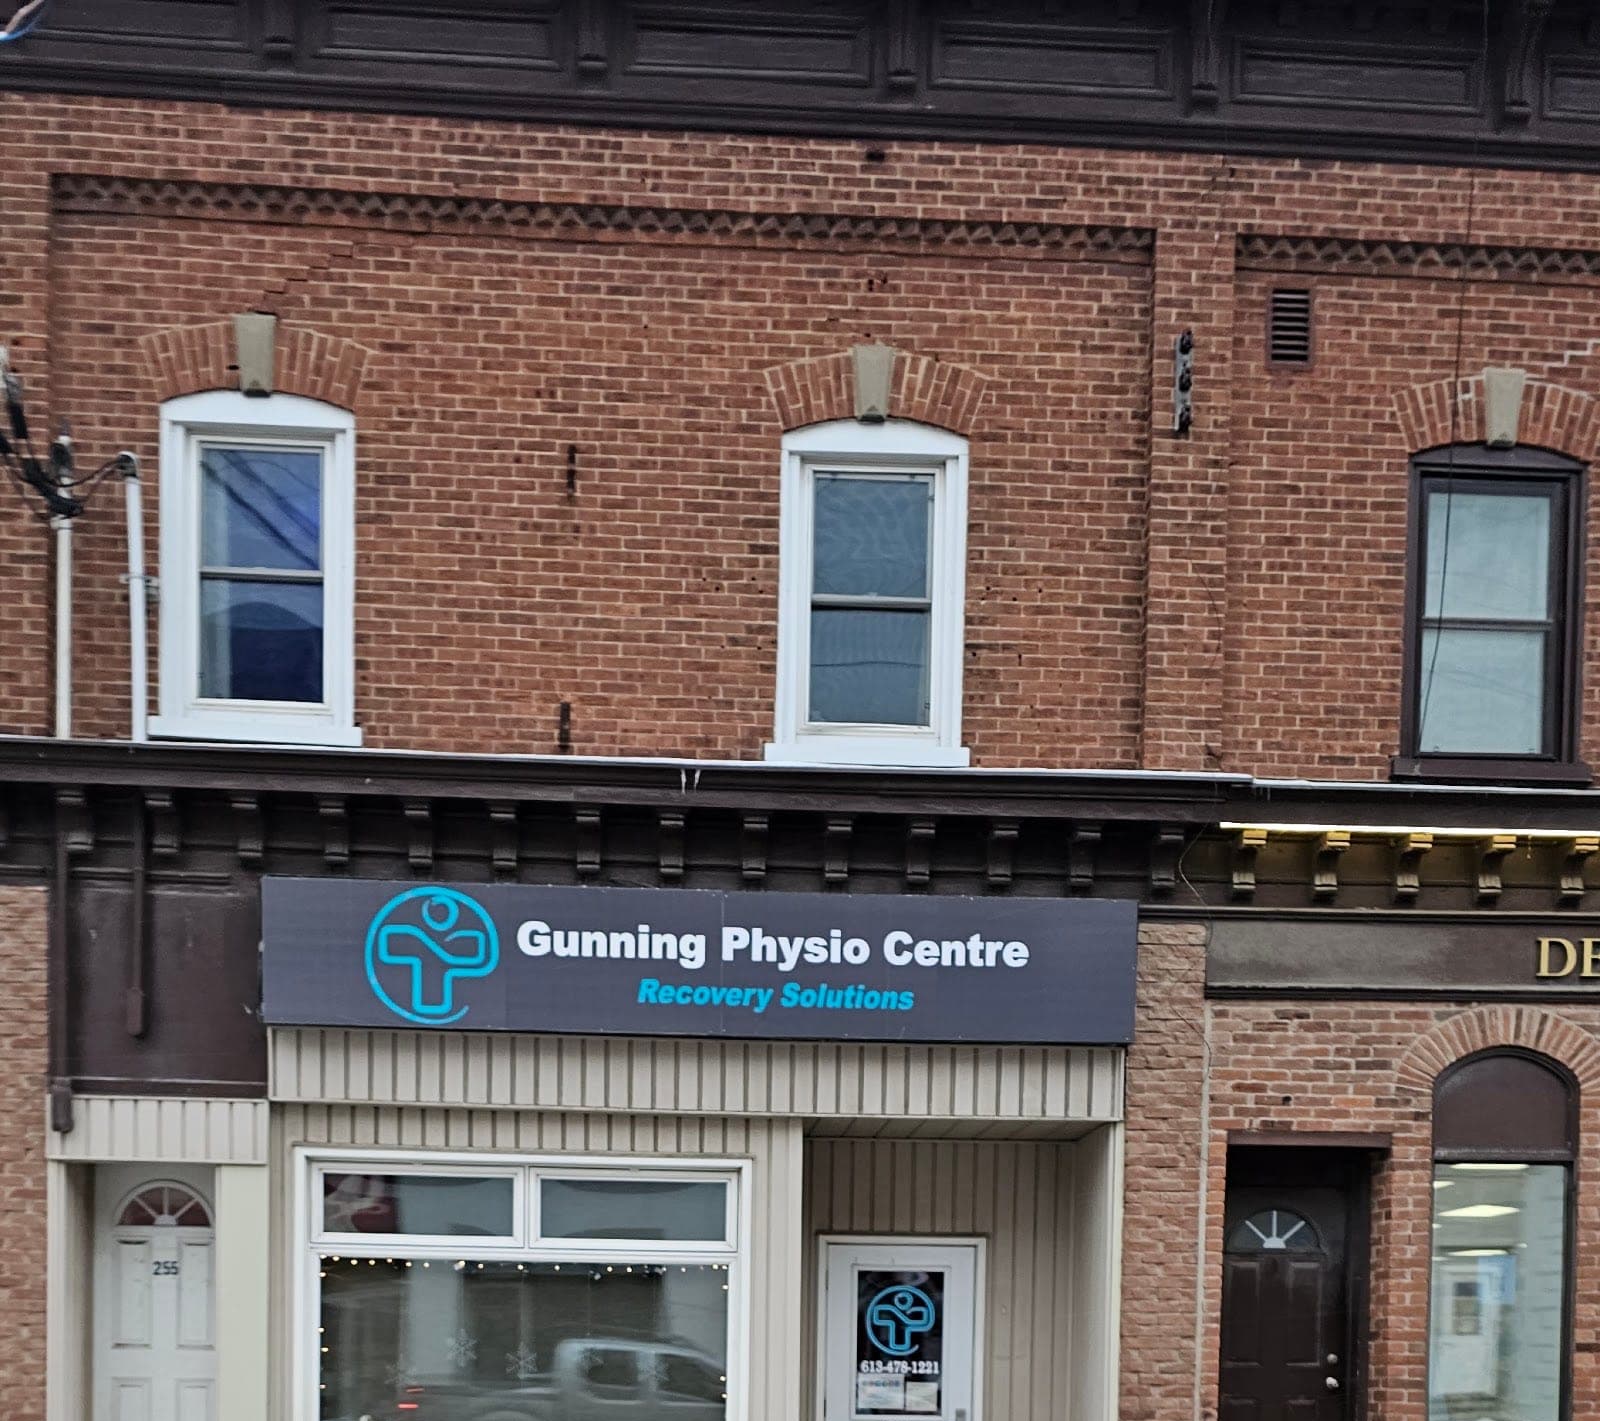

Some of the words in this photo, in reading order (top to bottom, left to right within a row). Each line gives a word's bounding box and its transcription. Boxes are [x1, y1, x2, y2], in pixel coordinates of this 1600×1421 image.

[517, 920, 706, 969] Gunning
[721, 926, 871, 972] Physio
[883, 930, 1030, 968] Centre
[637, 978, 774, 1013] Recovery
[780, 982, 914, 1010] Solutions
[152, 1261, 179, 1275] 255
